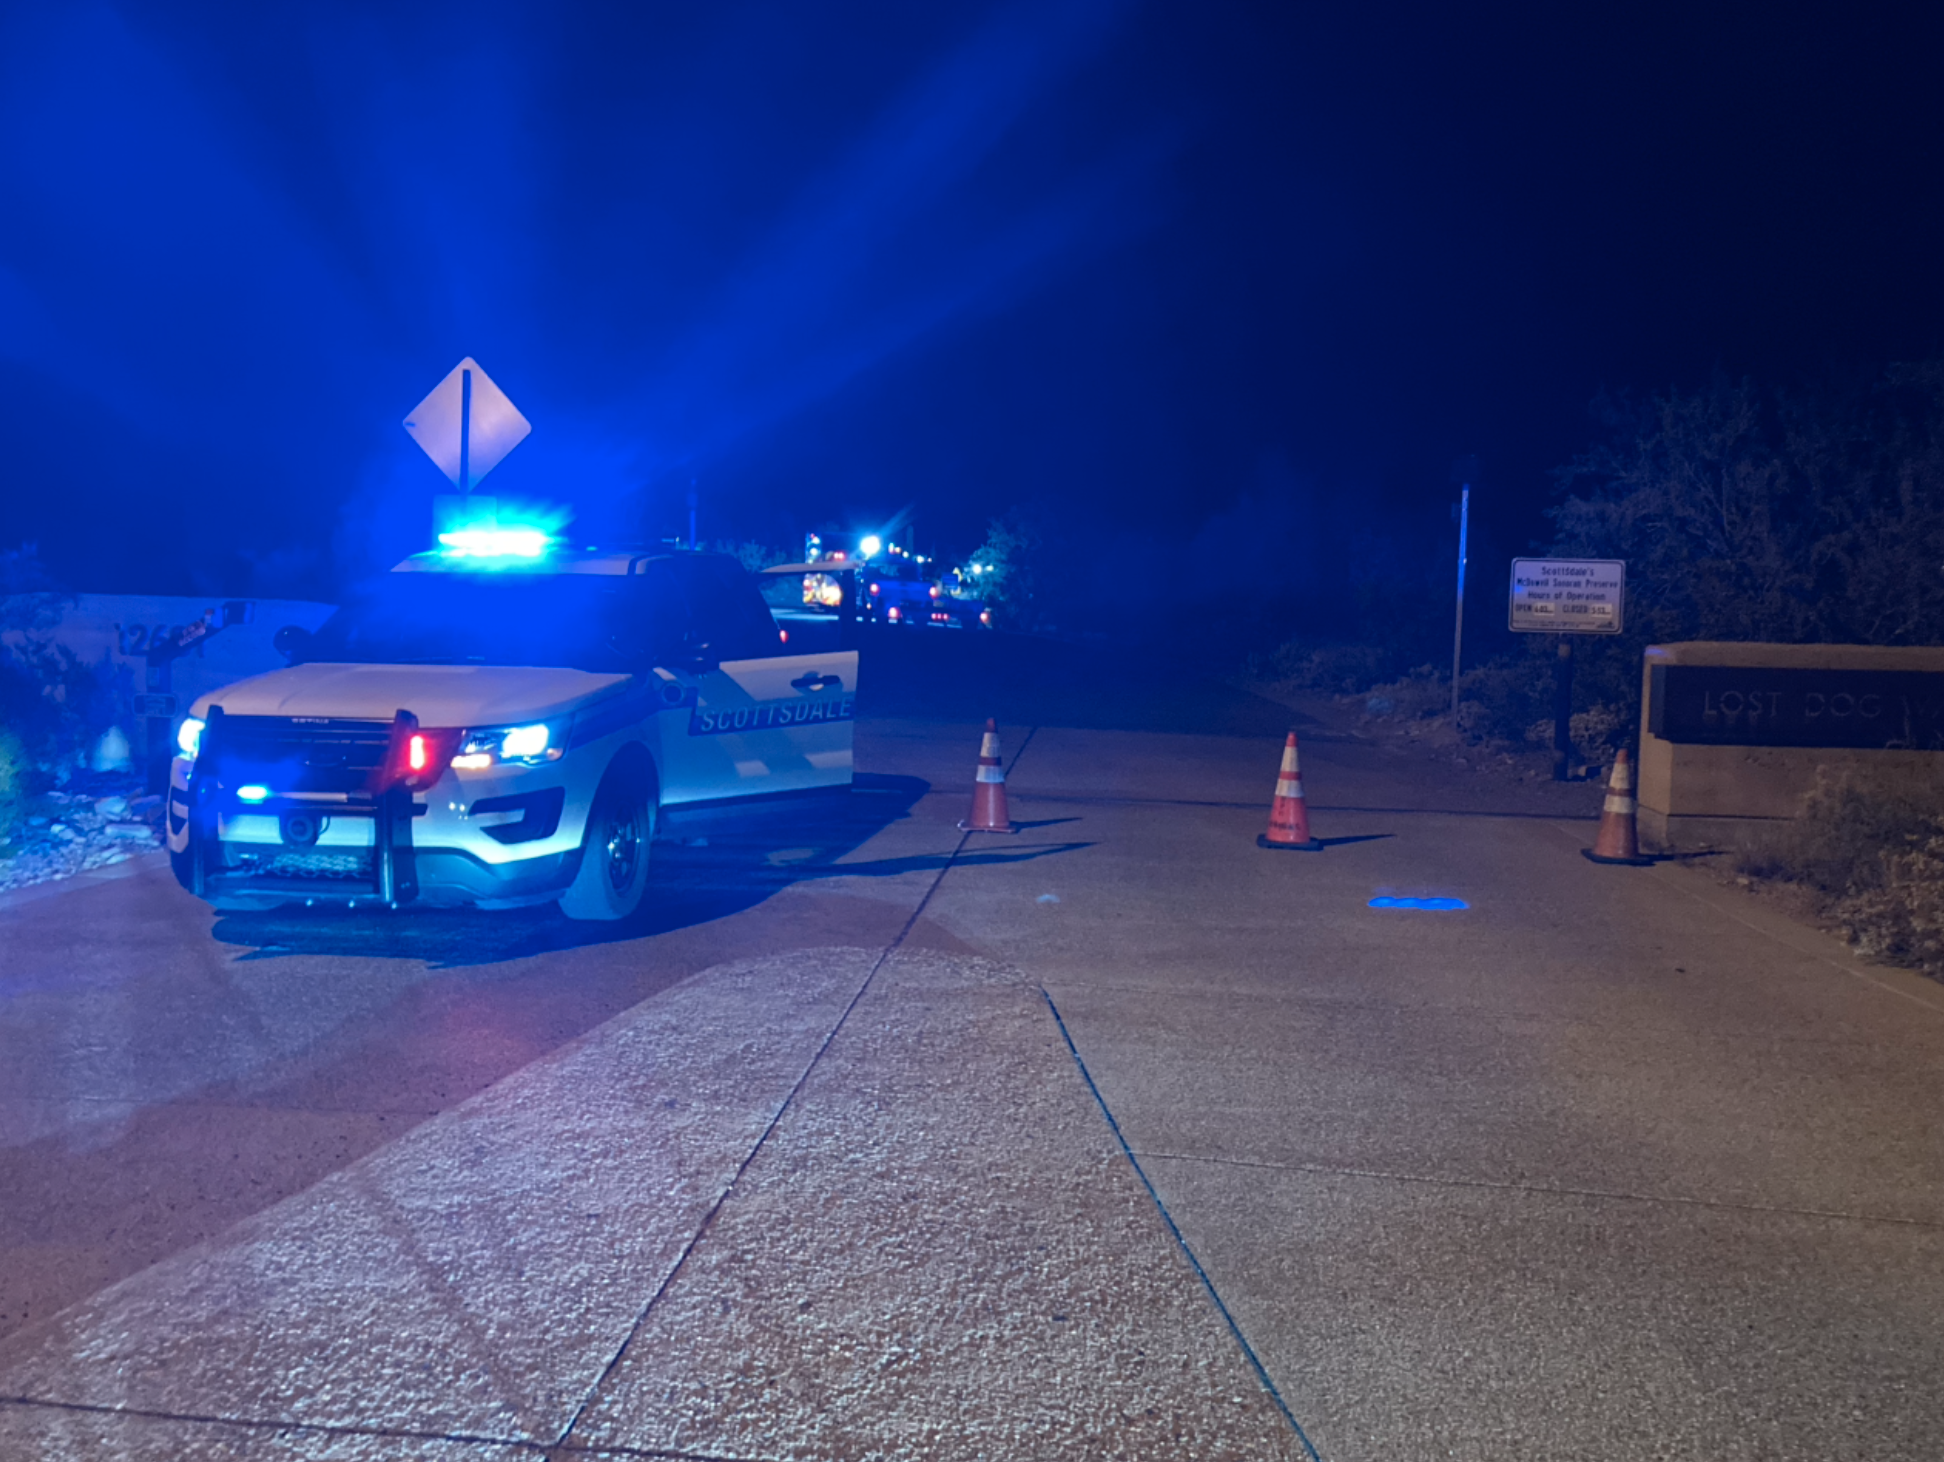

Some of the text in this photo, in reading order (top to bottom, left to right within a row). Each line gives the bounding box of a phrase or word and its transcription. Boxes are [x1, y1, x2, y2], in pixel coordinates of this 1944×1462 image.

[1541, 566, 1594, 577] Scottsdale's
[1552, 578, 1582, 588] Sonoran
[1586, 579, 1618, 588] Preserve
[1528, 590, 1606, 602] Hours of Operation
[1704, 690, 1882, 719] LOST DOG
[701, 697, 852, 732] SCOTTSDALE
